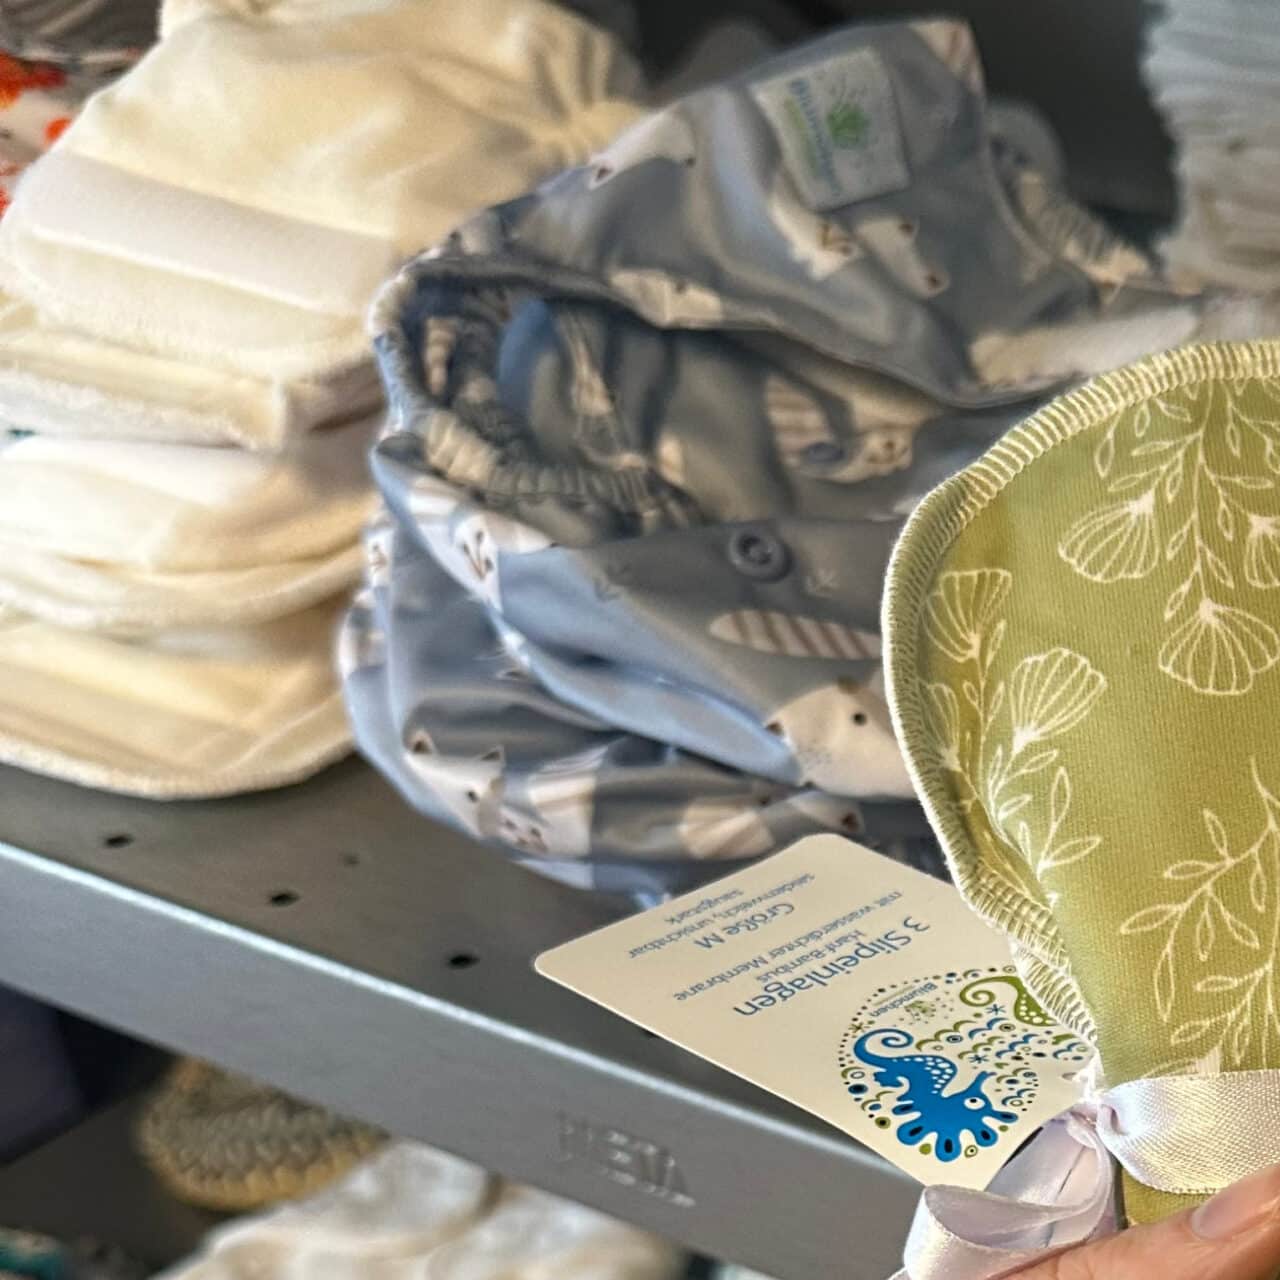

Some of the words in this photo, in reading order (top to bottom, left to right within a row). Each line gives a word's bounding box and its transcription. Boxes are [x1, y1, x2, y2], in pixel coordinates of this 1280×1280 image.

[628, 916, 715, 960] unsichtbar
[723, 902, 795, 933] Größe
[768, 905, 876, 961] wasserdichter
[903, 915, 931, 933] 3
[694, 931, 726, 950] M
[756, 929, 866, 983] Hanf-Bambus
[673, 955, 769, 1001] Membrane
[733, 930, 912, 1017] Slipeinlagen
[869, 981, 938, 1018] Blümchen
